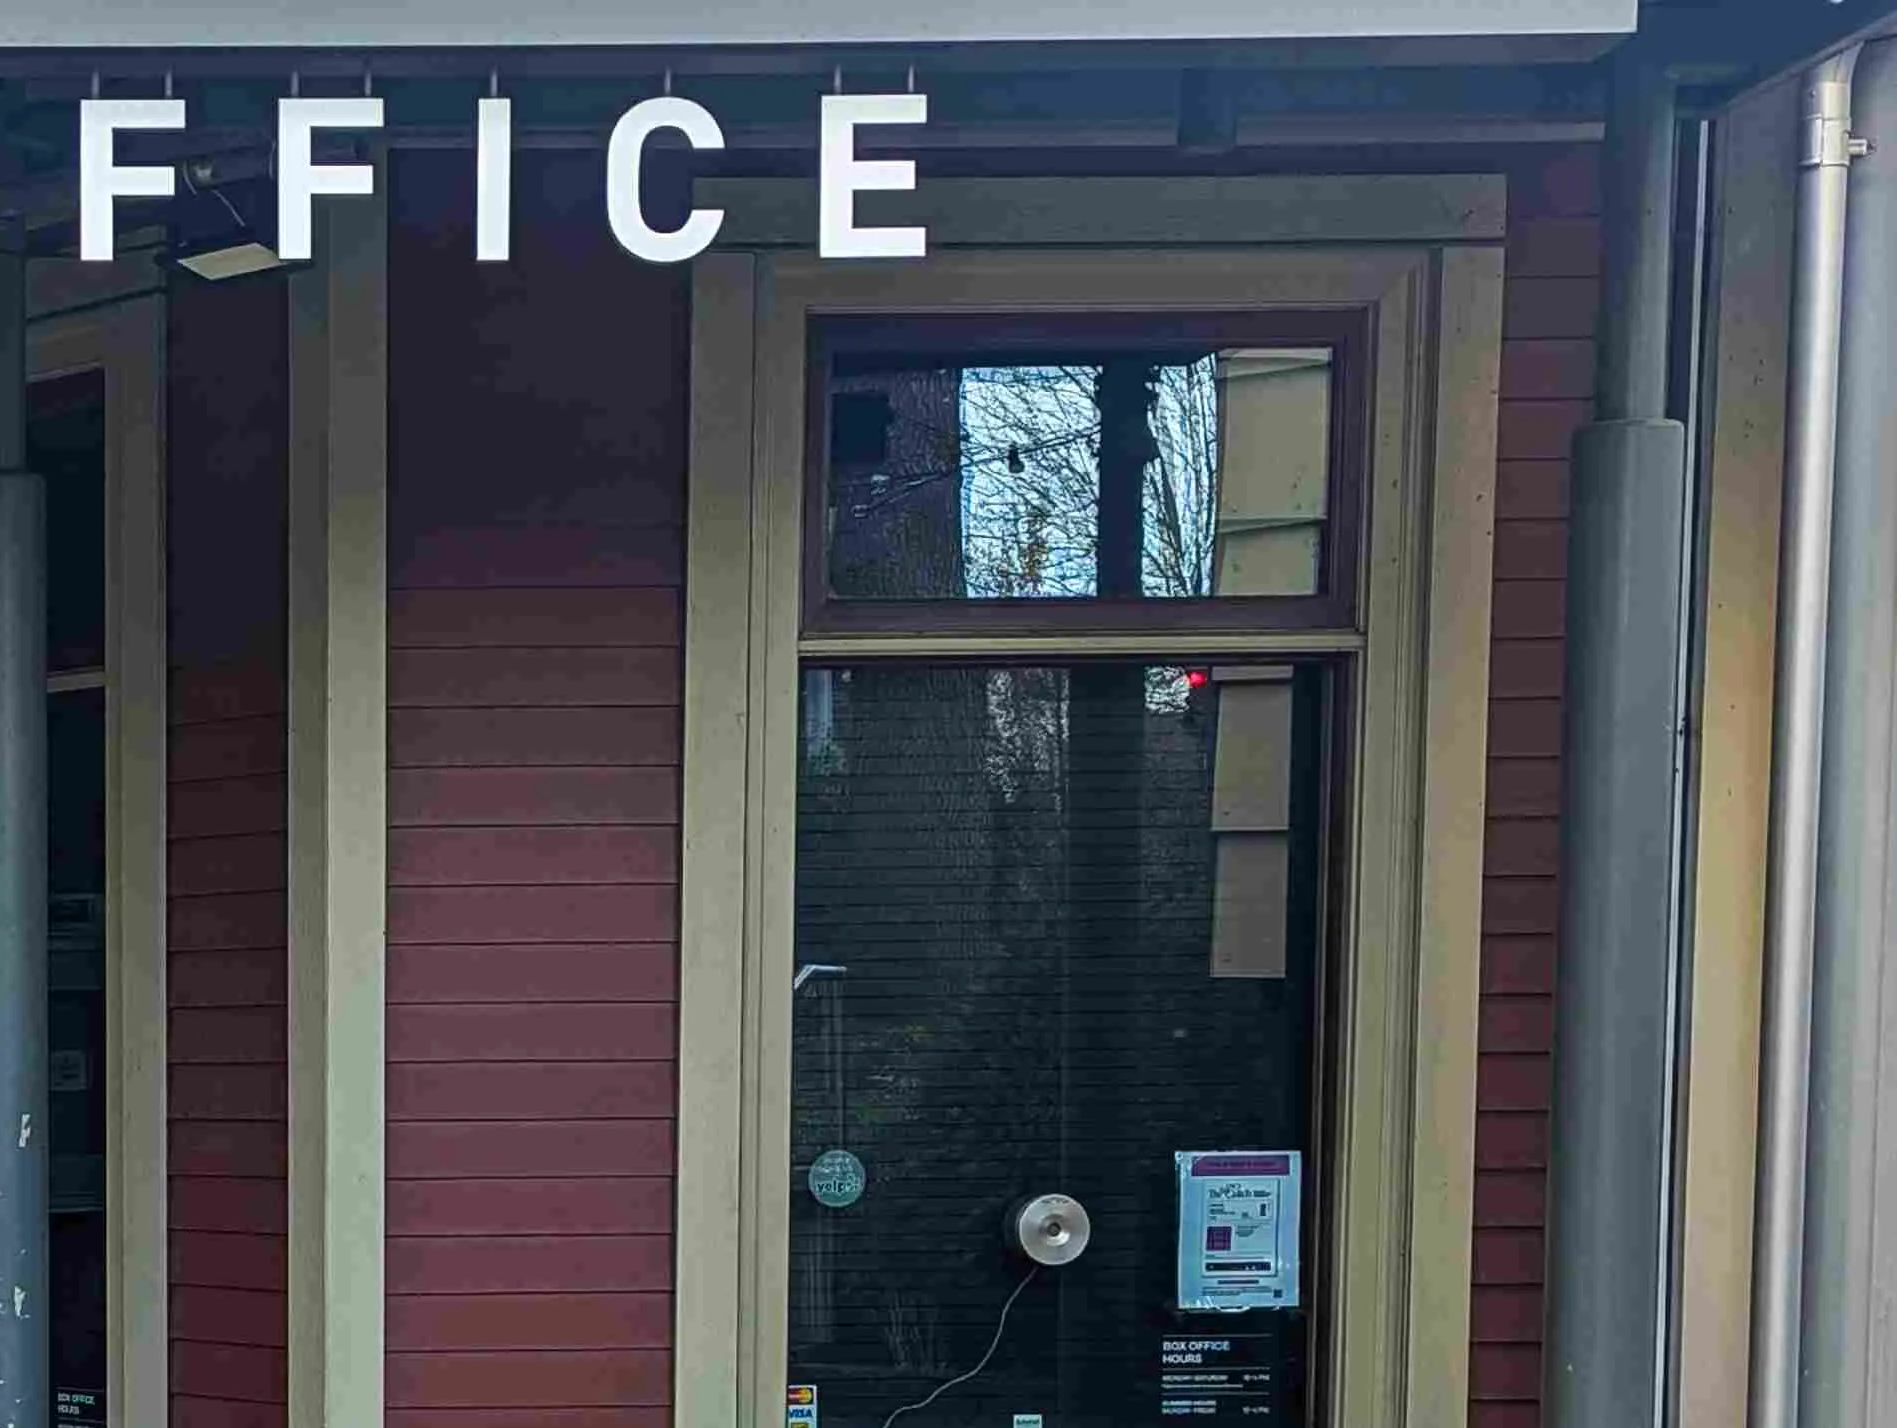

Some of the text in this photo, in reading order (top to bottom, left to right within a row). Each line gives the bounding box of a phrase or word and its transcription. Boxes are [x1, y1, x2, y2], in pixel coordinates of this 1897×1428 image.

[1162, 1340, 1230, 1351] BOX OFFICE
[1162, 1353, 1202, 1364] HOURS
